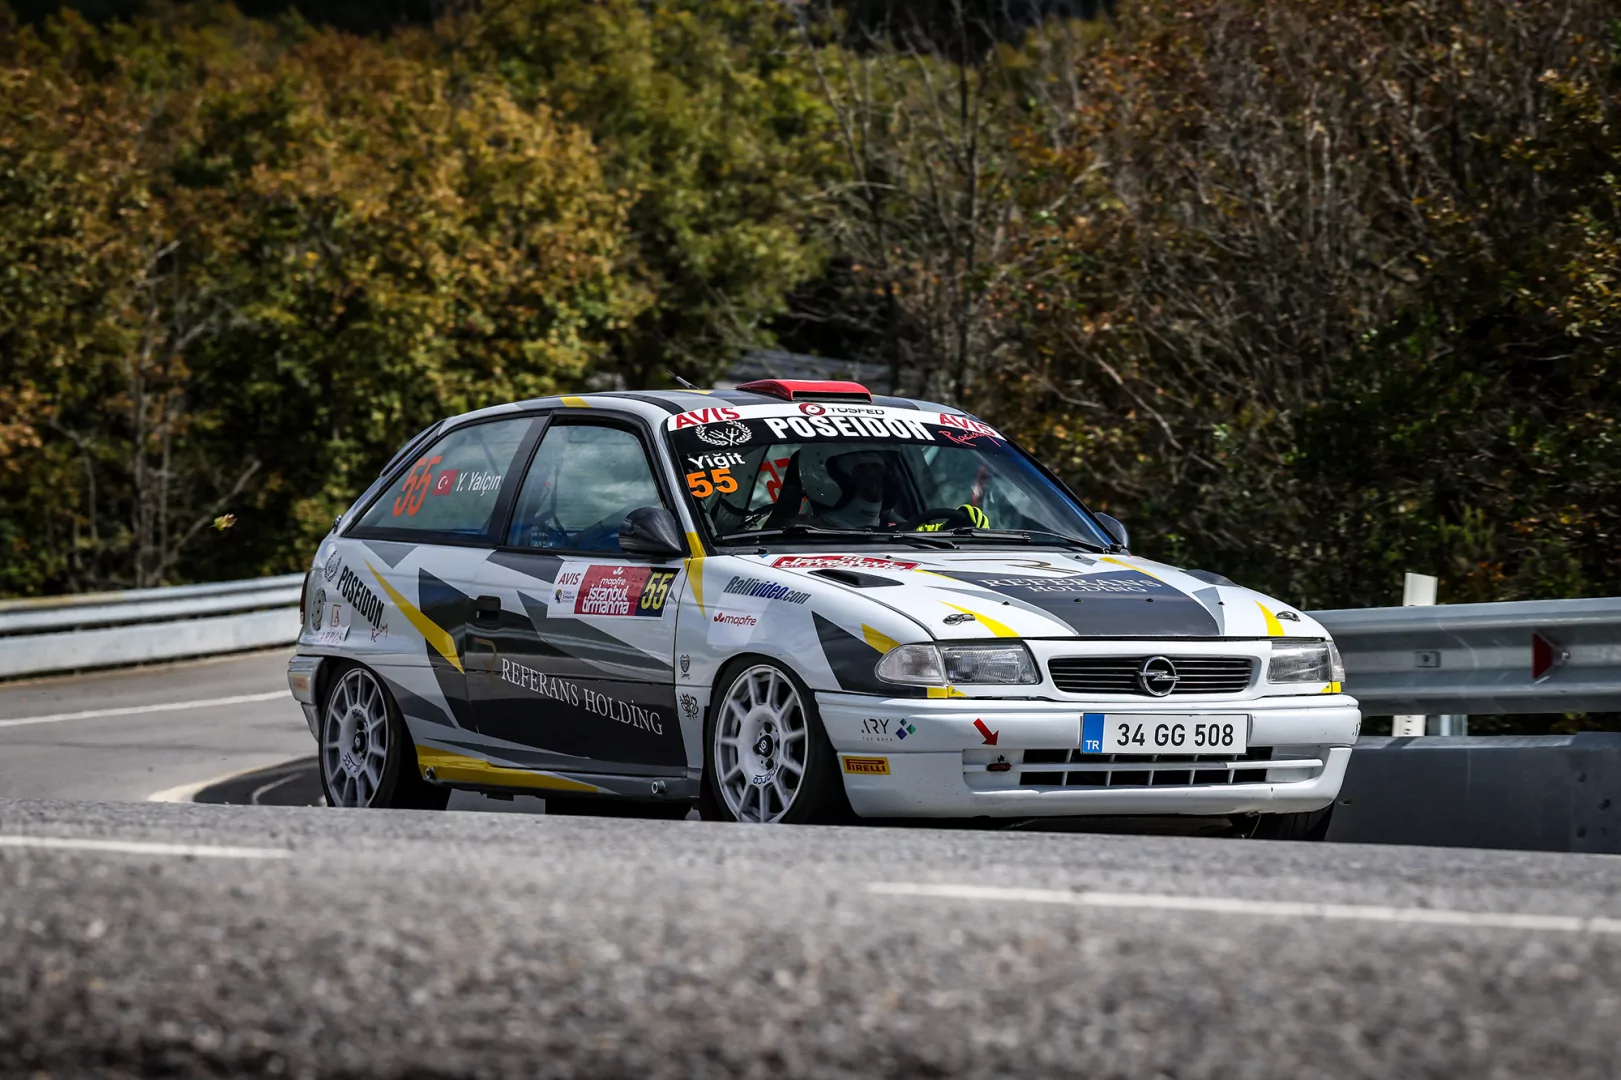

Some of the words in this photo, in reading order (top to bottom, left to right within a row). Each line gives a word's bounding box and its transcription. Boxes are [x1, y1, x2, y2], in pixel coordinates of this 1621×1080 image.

[676, 407, 741, 429] AVIS
[829, 407, 885, 416] TOSFED
[763, 415, 936, 441] POSEIDON
[939, 413, 997, 437] AVIS
[688, 452, 746, 470] Yiğit
[392, 455, 443, 517] 55
[456, 472, 469, 492] Y.
[686, 467, 738, 498] 55
[558, 573, 581, 585] AVIS
[600, 576, 627, 587] mapfre
[723, 575, 812, 605] Rallivideo.com
[336, 565, 384, 630] POSEIDON
[588, 584, 629, 602] istanbul
[641, 571, 674, 610] 55
[724, 615, 757, 627] mapfre
[501, 657, 579, 707] REFERANS
[1086, 740, 1100, 750] TR
[1117, 723, 1145, 746] 34
[1154, 724, 1186, 747] GG
[1194, 724, 1234, 747] 508
[846, 758, 886, 772] PIRELLI
